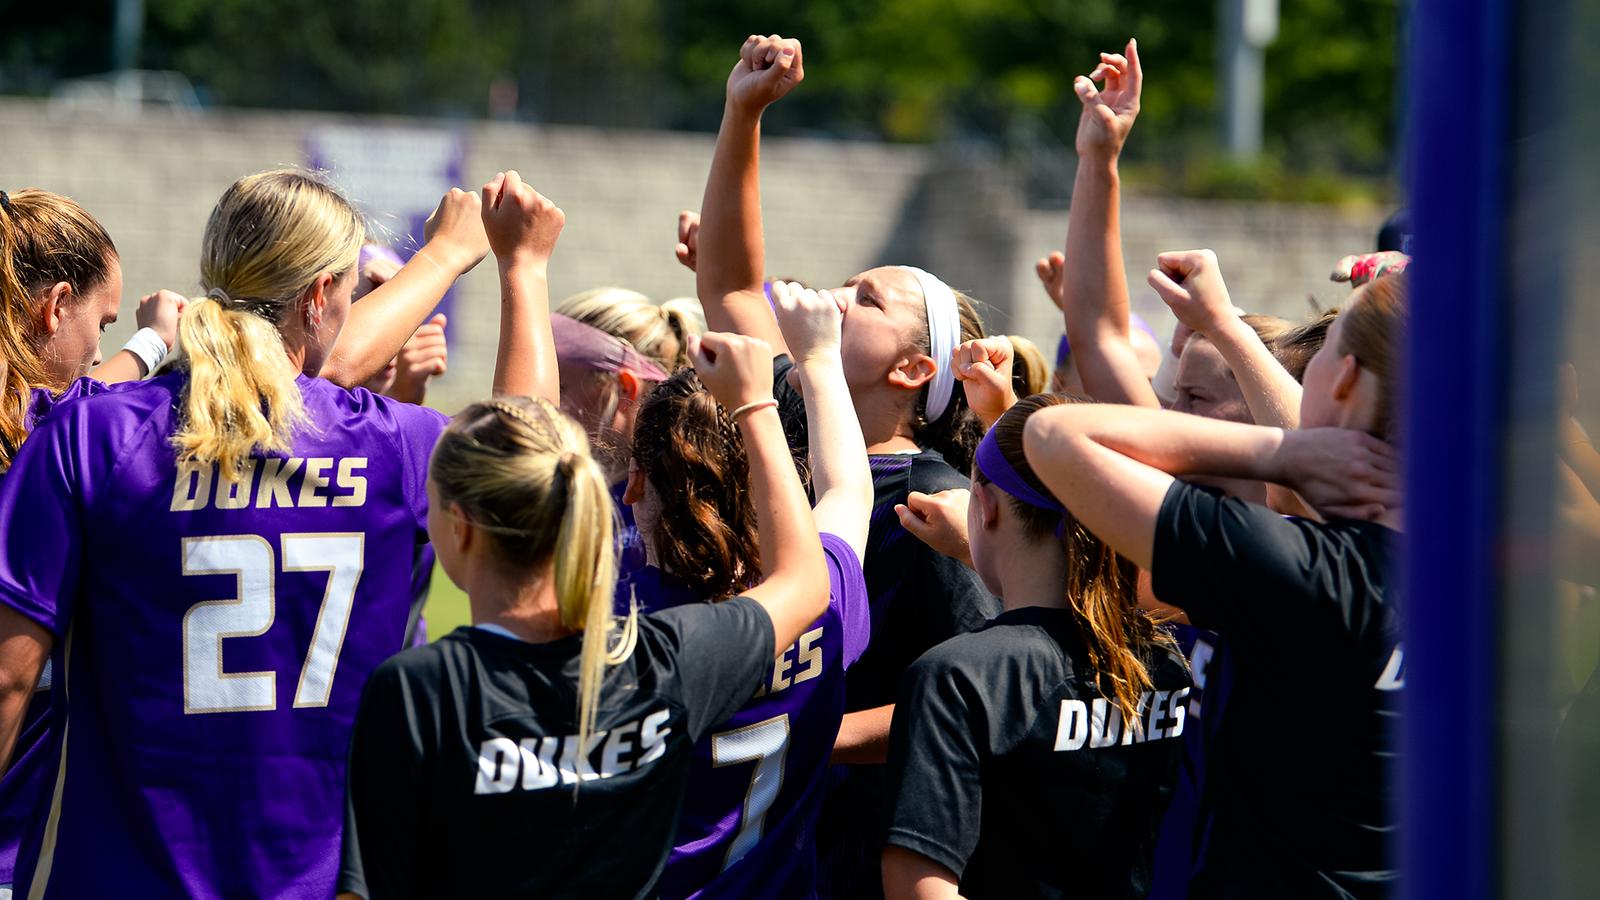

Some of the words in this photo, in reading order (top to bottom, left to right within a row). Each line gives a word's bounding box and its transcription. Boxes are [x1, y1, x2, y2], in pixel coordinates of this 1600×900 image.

[170, 457, 368, 511] DUKES
[182, 532, 365, 715] 27
[753, 626, 824, 698] ES
[474, 708, 671, 794] DUKES
[711, 713, 790, 873] 7
